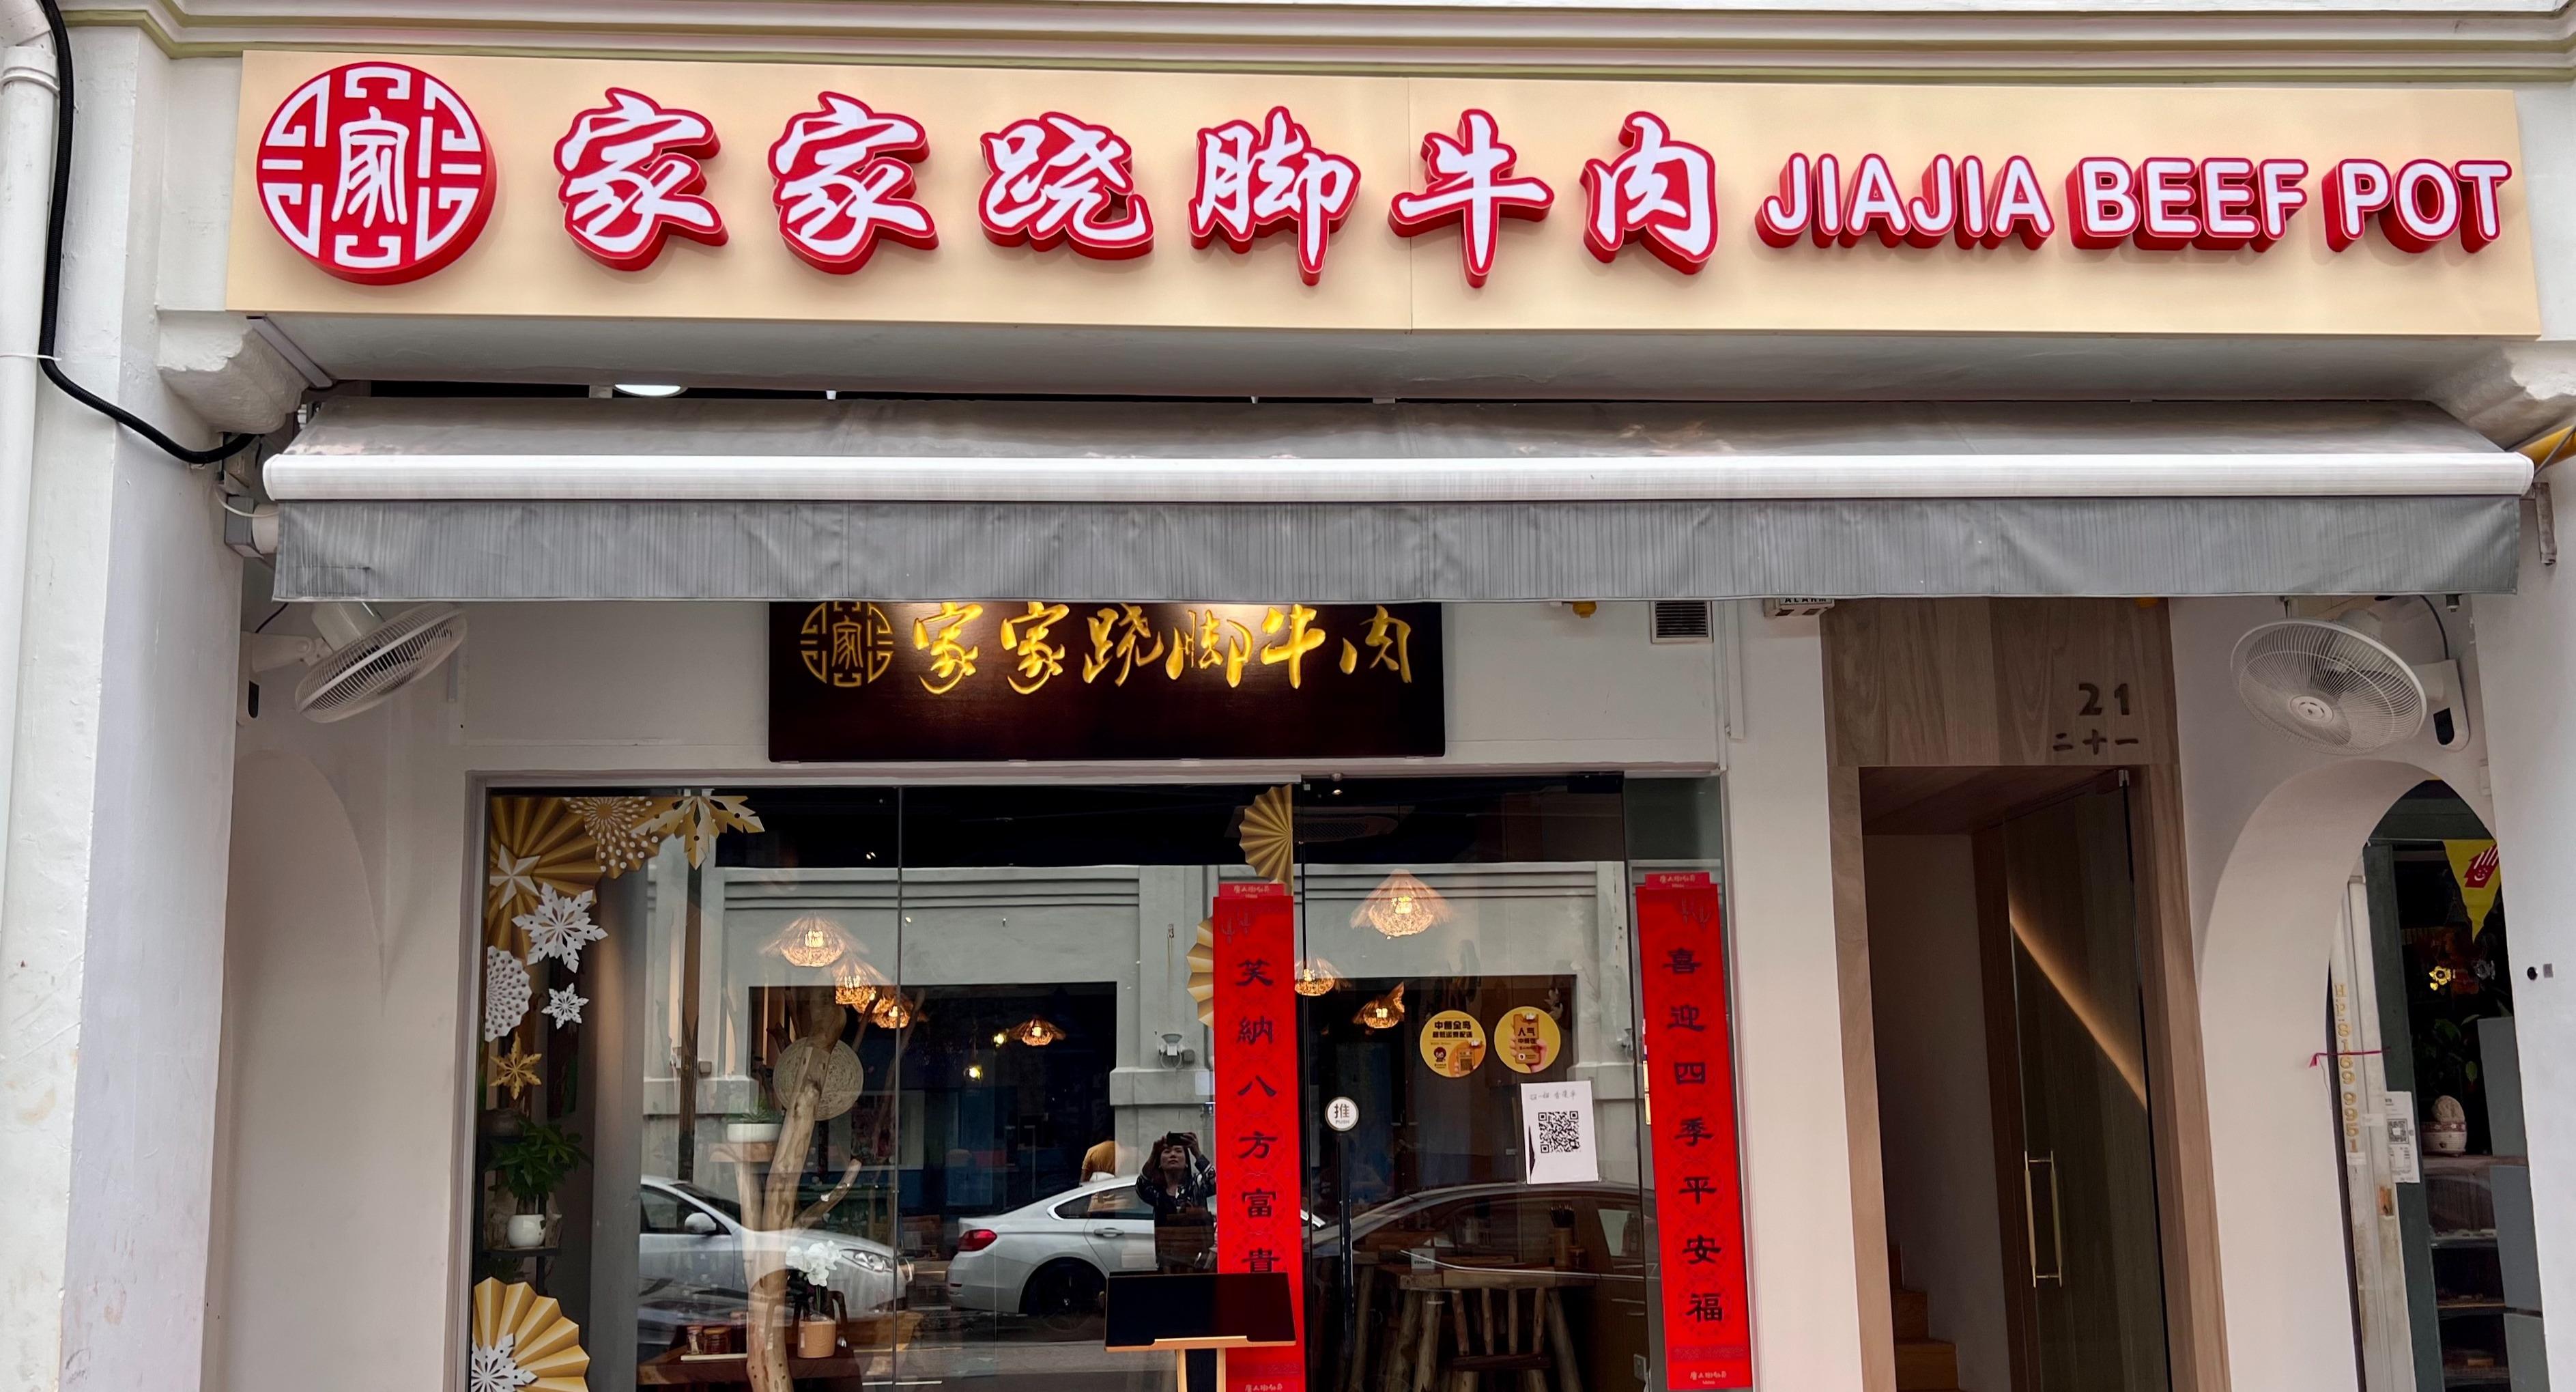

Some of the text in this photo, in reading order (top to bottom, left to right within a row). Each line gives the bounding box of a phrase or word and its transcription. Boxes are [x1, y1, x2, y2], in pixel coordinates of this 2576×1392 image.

[331, 105, 410, 229] 家
[555, 89, 1715, 279] 家家跷脚牛肉
[1761, 154, 2512, 242] JIAJIA BEEF POT
[913, 601, 1413, 695] 家家跷脚牛肉
[2052, 728, 2138, 755] 二十一
[2078, 683, 2130, 716] 21
[1334, 1103, 1350, 1119] 推
[1662, 947, 1723, 1323] 喜迎四季平安福
